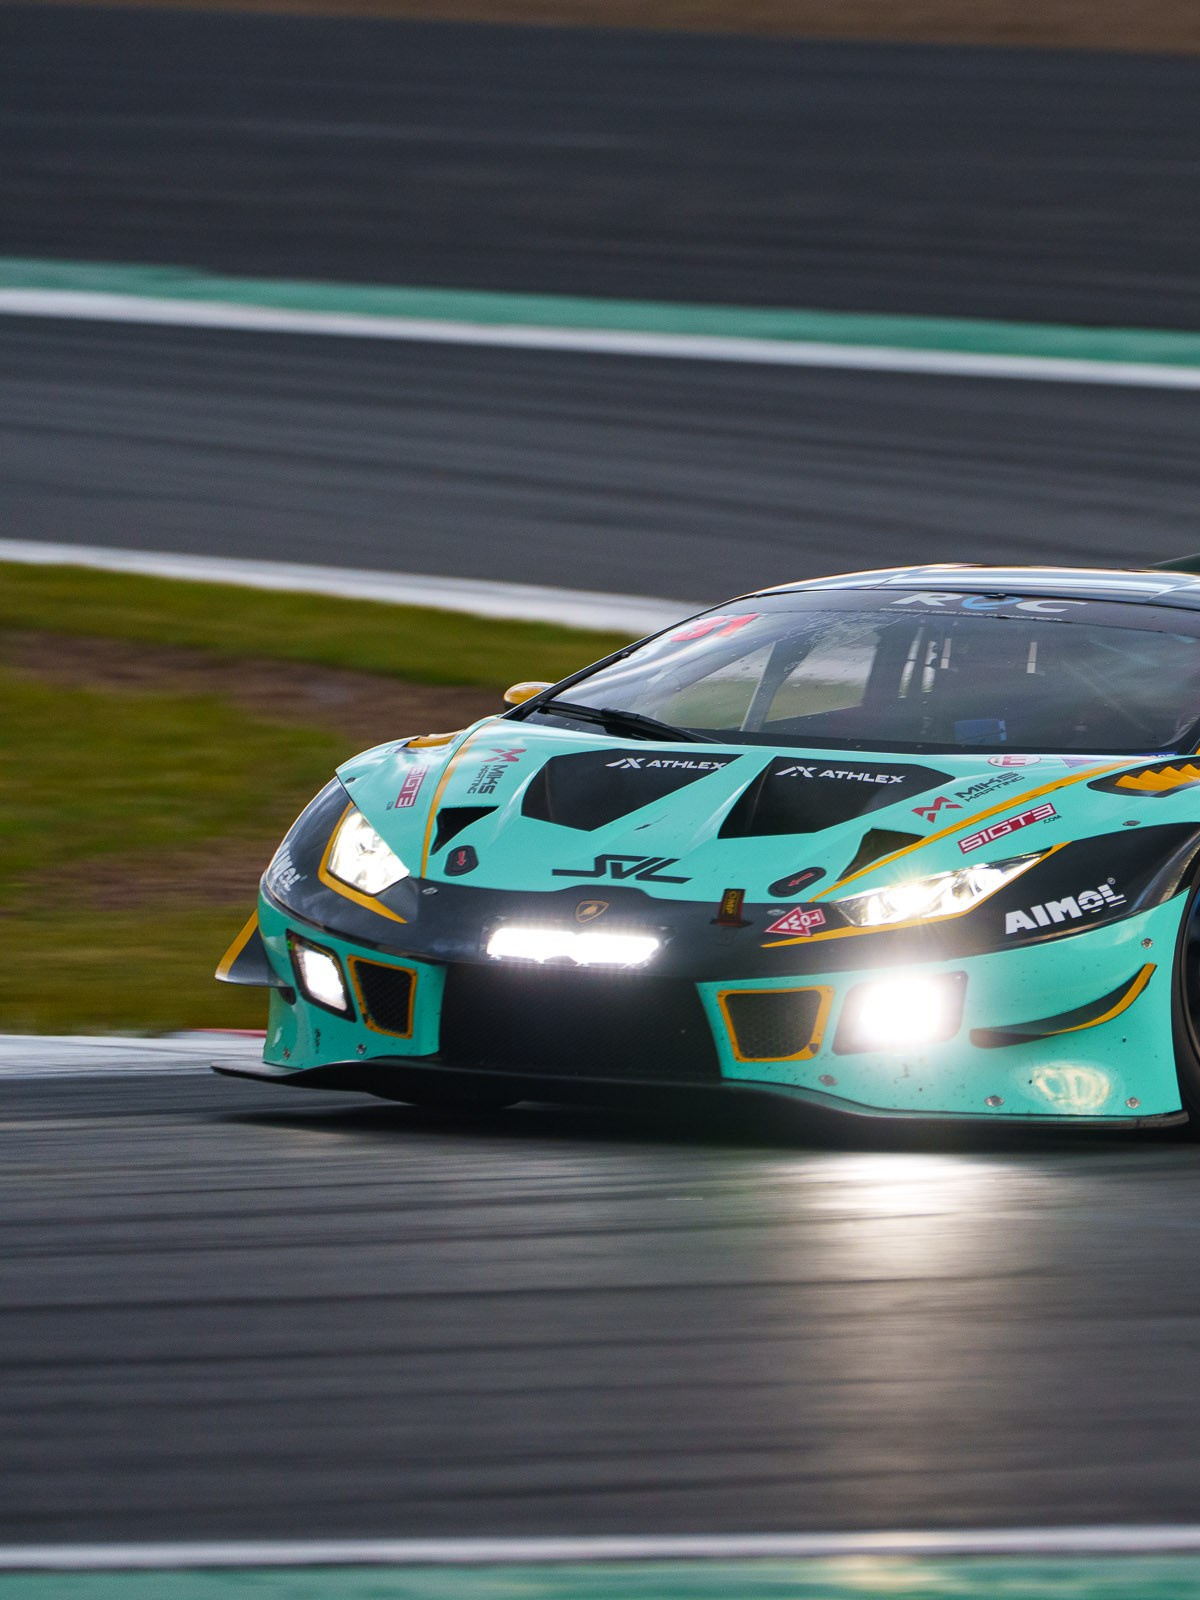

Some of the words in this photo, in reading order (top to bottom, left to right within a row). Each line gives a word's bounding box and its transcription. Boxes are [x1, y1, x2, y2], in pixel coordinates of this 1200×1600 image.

[646, 759, 727, 772] ATHLEX
[819, 769, 906, 785] ATHLEX
[954, 771, 1020, 798] MIKS
[964, 775, 1026, 802] KARTING
[552, 854, 693, 884] SVL
